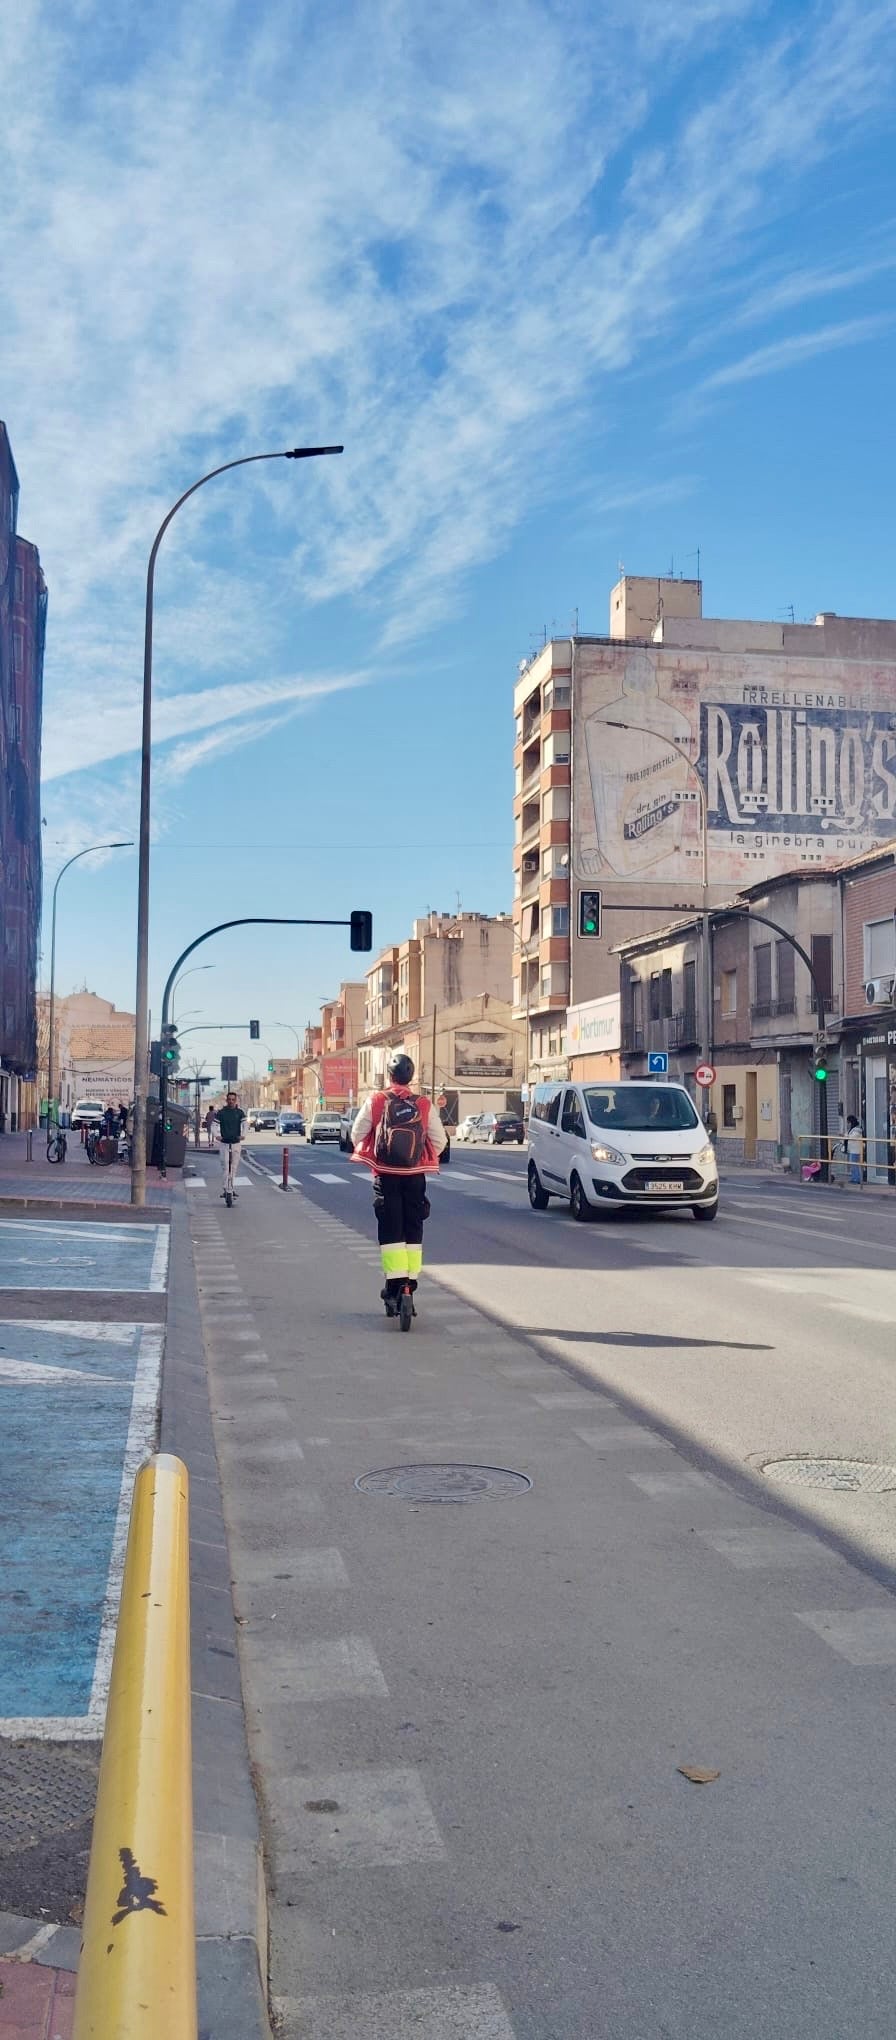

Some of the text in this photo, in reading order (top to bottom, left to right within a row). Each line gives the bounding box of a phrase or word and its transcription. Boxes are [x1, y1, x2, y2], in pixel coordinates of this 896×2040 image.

[742, 691, 870, 709] IRRELLENABLE
[705, 705, 896, 830] Rolling's
[628, 802, 674, 838] Rolling's
[730, 832, 745, 845] la
[755, 833, 825, 849] ginebra
[581, 1016, 615, 1041] Hortimur
[816, 1032, 825, 1043] 12
